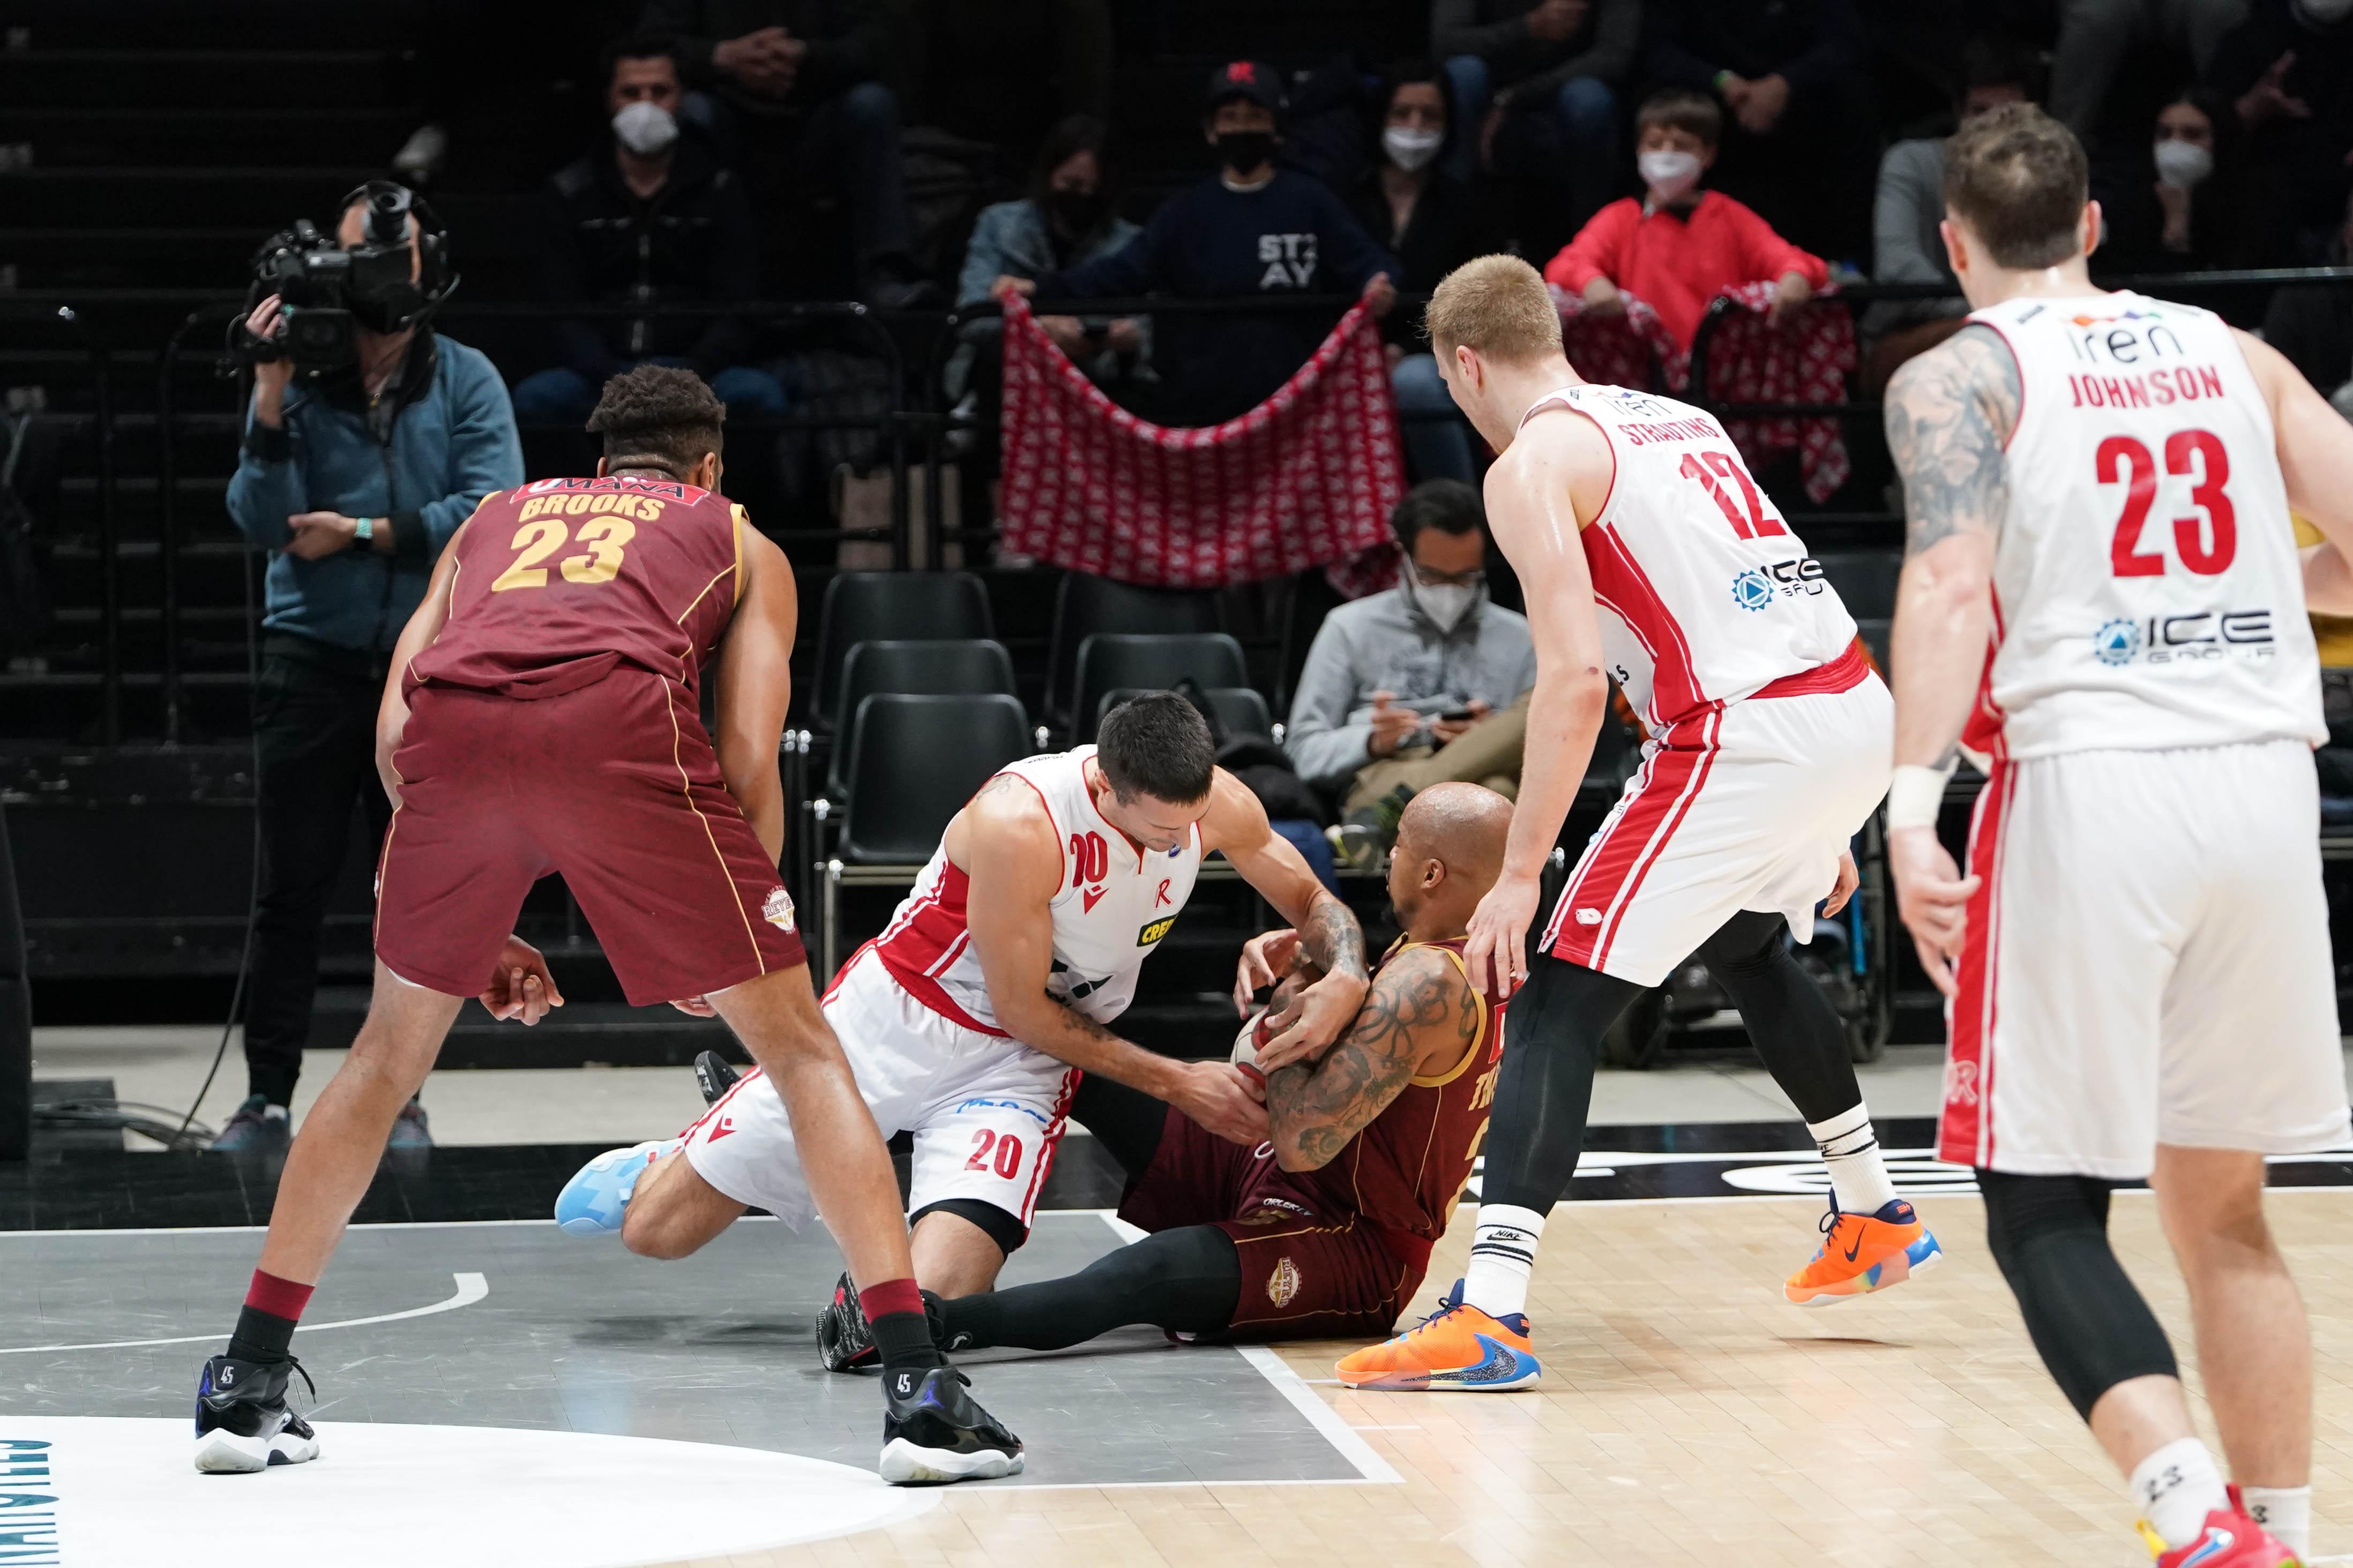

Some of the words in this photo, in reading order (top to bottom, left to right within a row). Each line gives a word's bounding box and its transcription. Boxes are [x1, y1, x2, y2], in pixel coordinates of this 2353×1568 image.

[2068, 365, 2224, 409] JOHNSON
[1617, 417, 1720, 446] STRAUTINS
[518, 494, 666, 523] BROOKS
[1679, 451, 1787, 541] 12
[2096, 429, 2237, 577] 23
[491, 516, 636, 592] 23
[2149, 610, 2274, 648] ICE
[1070, 830, 1108, 888] 20
[761, 896, 794, 918] REYE
[964, 1128, 1022, 1180] 20
[220, 1366, 234, 1384] 45
[897, 1374, 910, 1393] 45
